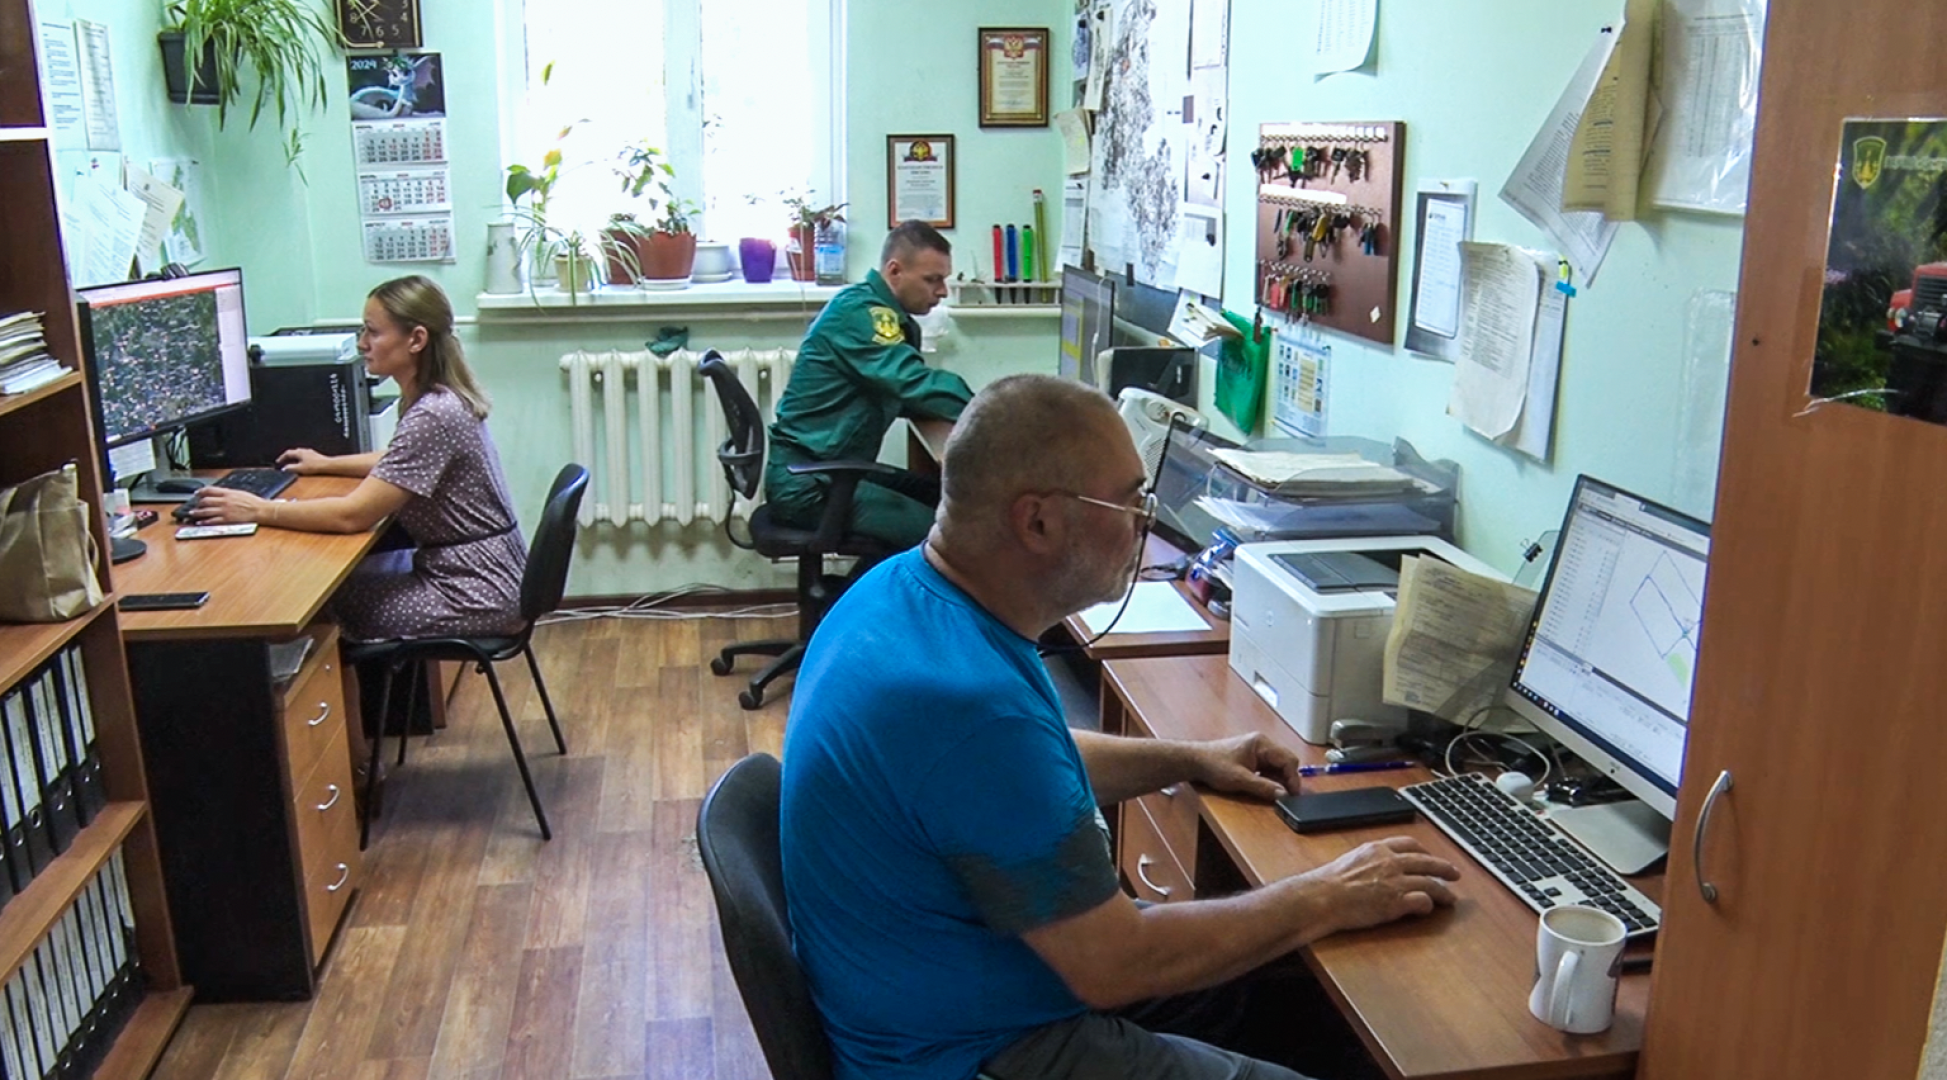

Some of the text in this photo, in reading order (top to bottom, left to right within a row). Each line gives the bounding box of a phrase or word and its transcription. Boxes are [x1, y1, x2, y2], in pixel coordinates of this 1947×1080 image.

[400, 12, 408, 22] 4
[360, 25, 368, 36] 7
[375, 25, 385, 38] 6
[392, 24, 399, 36] 5
[350, 60, 377, 70] 2024
